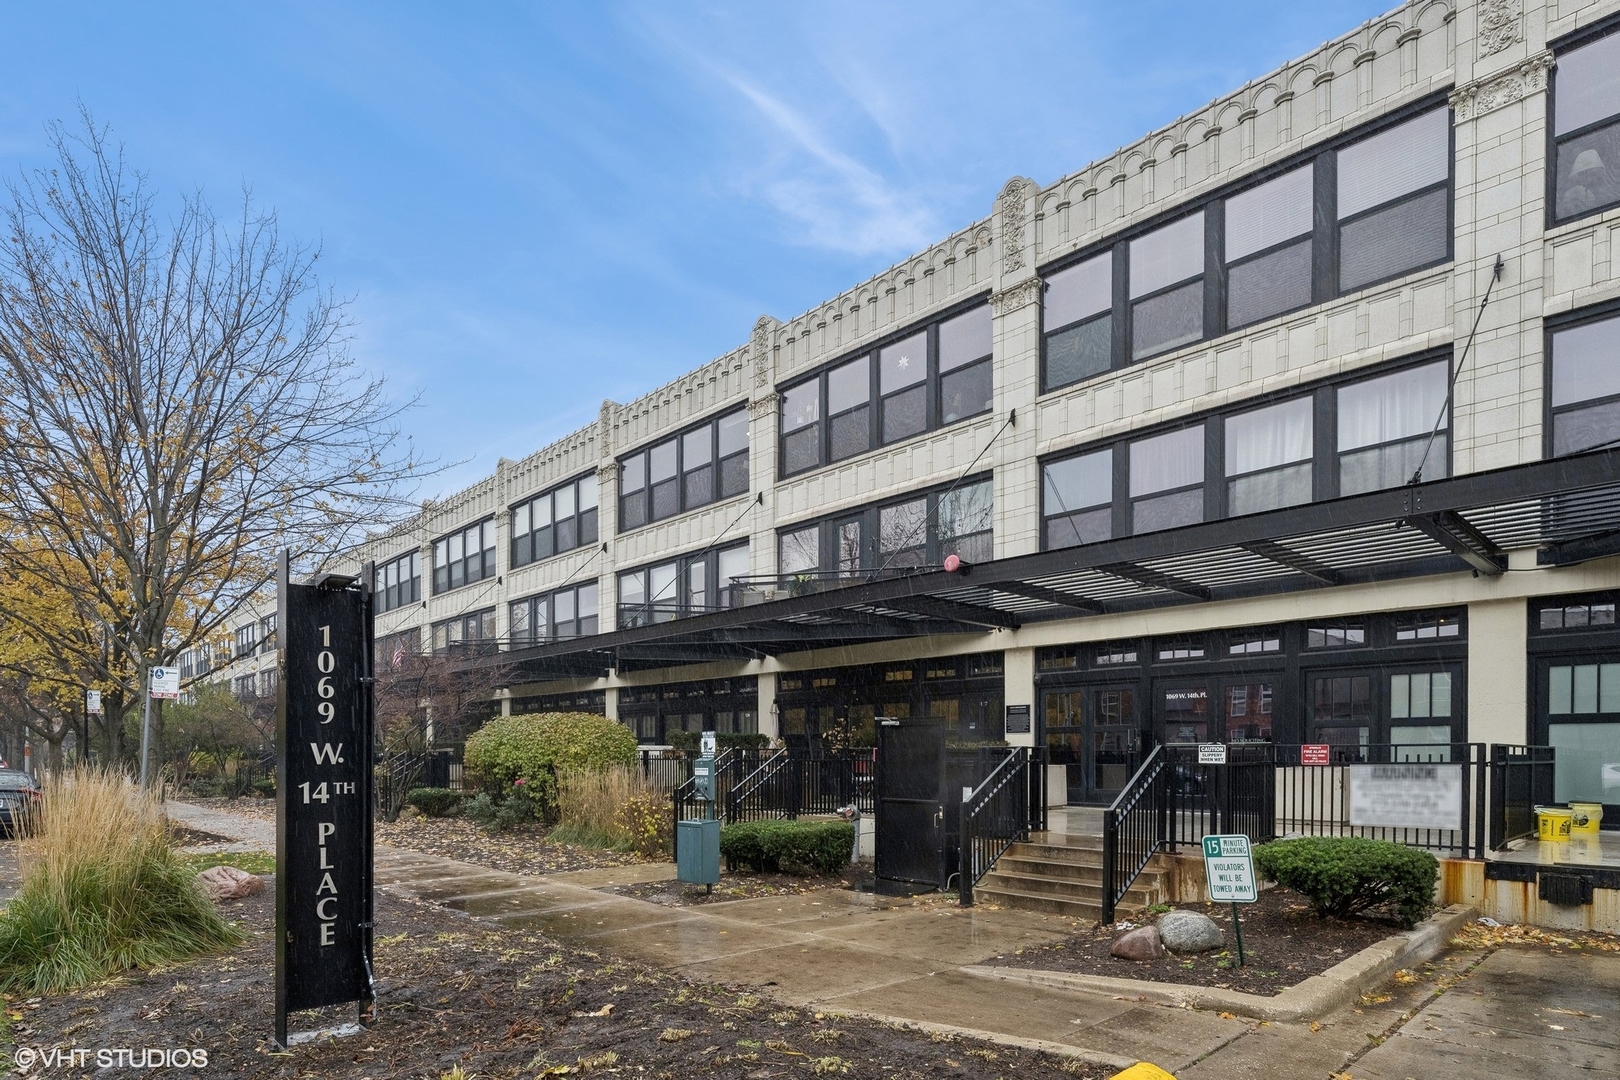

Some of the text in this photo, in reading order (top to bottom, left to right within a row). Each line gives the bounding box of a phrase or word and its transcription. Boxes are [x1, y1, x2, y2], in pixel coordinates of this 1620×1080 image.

[317, 625, 335, 725] 1069
[310, 742, 345, 765] W.
[298, 781, 356, 804] 14TH
[1207, 841, 1219, 854] 15
[316, 822, 339, 947] PLACE
